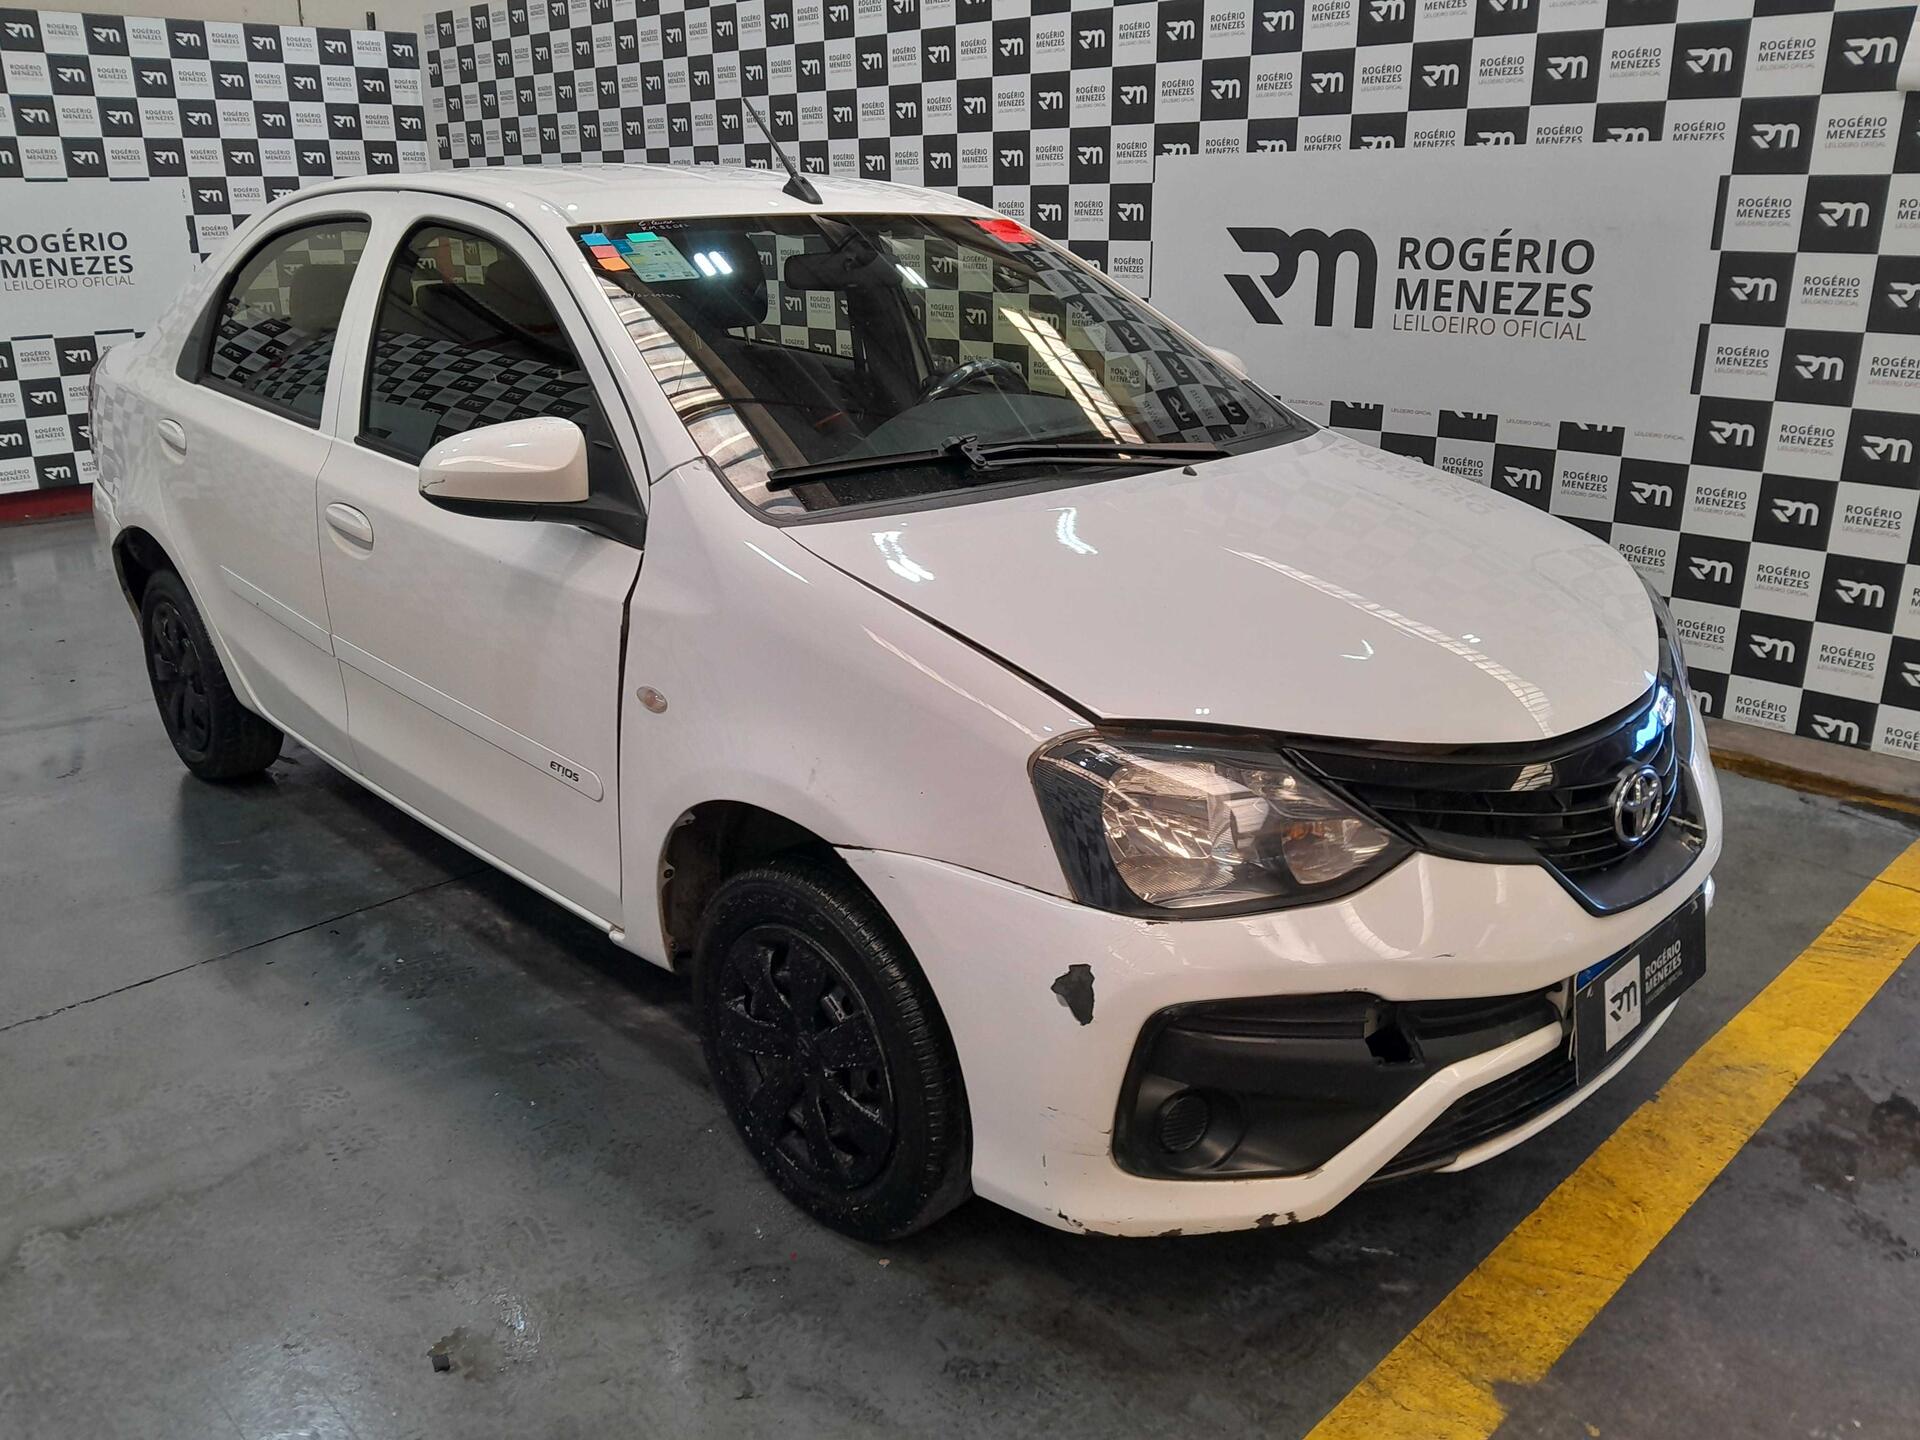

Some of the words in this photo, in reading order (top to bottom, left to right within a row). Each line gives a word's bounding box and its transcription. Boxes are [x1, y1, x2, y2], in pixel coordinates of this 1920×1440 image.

[1312, 1, 1350, 12] ROGÉRIO
[1211, 12, 1245, 22] ROGÉRIO
[1312, 10, 1350, 21] MENEZES
[1119, 21, 1150, 31] ROGÉRIO
[1210, 20, 1245, 31] MENEZES
[1036, 30, 1064, 40] ROGÉRIO
[1119, 30, 1150, 40] MENEZES
[1036, 38, 1065, 48] MENEZES
[1760, 38, 1816, 51] ROGÉRIO
[1612, 48, 1661, 59] ROGÉRIO
[1758, 50, 1815, 61] MENEZES
[1480, 56, 1524, 67] ROGÉRIO
[1610, 58, 1660, 69] MENEZES
[1362, 64, 1402, 75] ROGÉRIO
[1479, 66, 1524, 77] MENEZES
[1257, 72, 1293, 82] ROGÉRIO
[1362, 74, 1402, 84] MENEZES
[1162, 79, 1194, 88] ROGÉRIO
[1256, 81, 1292, 91] MENEZES
[1076, 85, 1105, 94] ROGÉRIO
[1162, 88, 1194, 96] MENEZES
[1076, 93, 1105, 102] MENEZES
[1674, 121, 1725, 132] ROGÉRIO
[1828, 117, 1887, 128] ROGÉRIO
[1414, 130, 1455, 139] ROGÉRIO
[1537, 125, 1583, 135] ROGÉRIO
[1826, 128, 1885, 138] MENEZES
[1206, 138, 1239, 147] ROGÉRIO
[1305, 134, 1341, 143] ROGÉRIO
[1036, 145, 1063, 153] ROGÉRIO
[1117, 141, 1147, 150] ROGÉRIO
[1117, 150, 1147, 158] MENEZES
[1074, 200, 1103, 208] ROGÉRIO
[1738, 197, 1792, 208] ROGÉRIO
[1737, 209, 1790, 217] MENEZES
[0, 228, 127, 254] ROGÉRIO
[1398, 229, 1595, 275] ROGÉRIO
[1114, 257, 1143, 265] ROGÉRIO
[0, 255, 133, 279] MENEZES
[1114, 265, 1143, 273] MENEZES
[4, 278, 78, 291] LEILOEIRO
[82, 275, 135, 288] OFICIAL
[1804, 276, 1860, 287] ROGÉRIO
[1803, 287, 1859, 297] MENEZES
[1394, 278, 1594, 318] MENEZES
[1393, 313, 1496, 336] LEILOEIRO
[1503, 318, 1586, 341] OFICIAL
[1717, 346, 1769, 358] ROGÉRIO
[1716, 356, 1768, 368] MENEZES
[1781, 424, 1835, 437] ROGÉRIO
[1779, 434, 1834, 447] MENEZES
[1443, 457, 1483, 468] ROGÉRIO
[1563, 471, 1608, 483] ROGÉRIO
[1562, 480, 1607, 491] MENEZES
[1696, 487, 1747, 500] ROGÉRIO
[1695, 496, 1746, 509] MENEZES
[1846, 505, 1902, 520] ROGÉRIO
[1844, 515, 1901, 529] MENEZES
[1619, 544, 1666, 557] ROGÉRIO
[1758, 564, 1810, 579] ROGÉRIO
[1756, 574, 1809, 589] MENEZES
[1677, 618, 1725, 634] ROGÉRIO
[1821, 644, 1875, 661] ROGÉRIO
[1819, 654, 1874, 670] MENEZES
[1736, 696, 1787, 713] ROGÉRIO
[1735, 705, 1786, 722] MENEZES
[550, 761, 579, 782] ETIOS
[1645, 940, 1681, 979] ROGÉRIO
[1645, 952, 1682, 994] MENEZES
